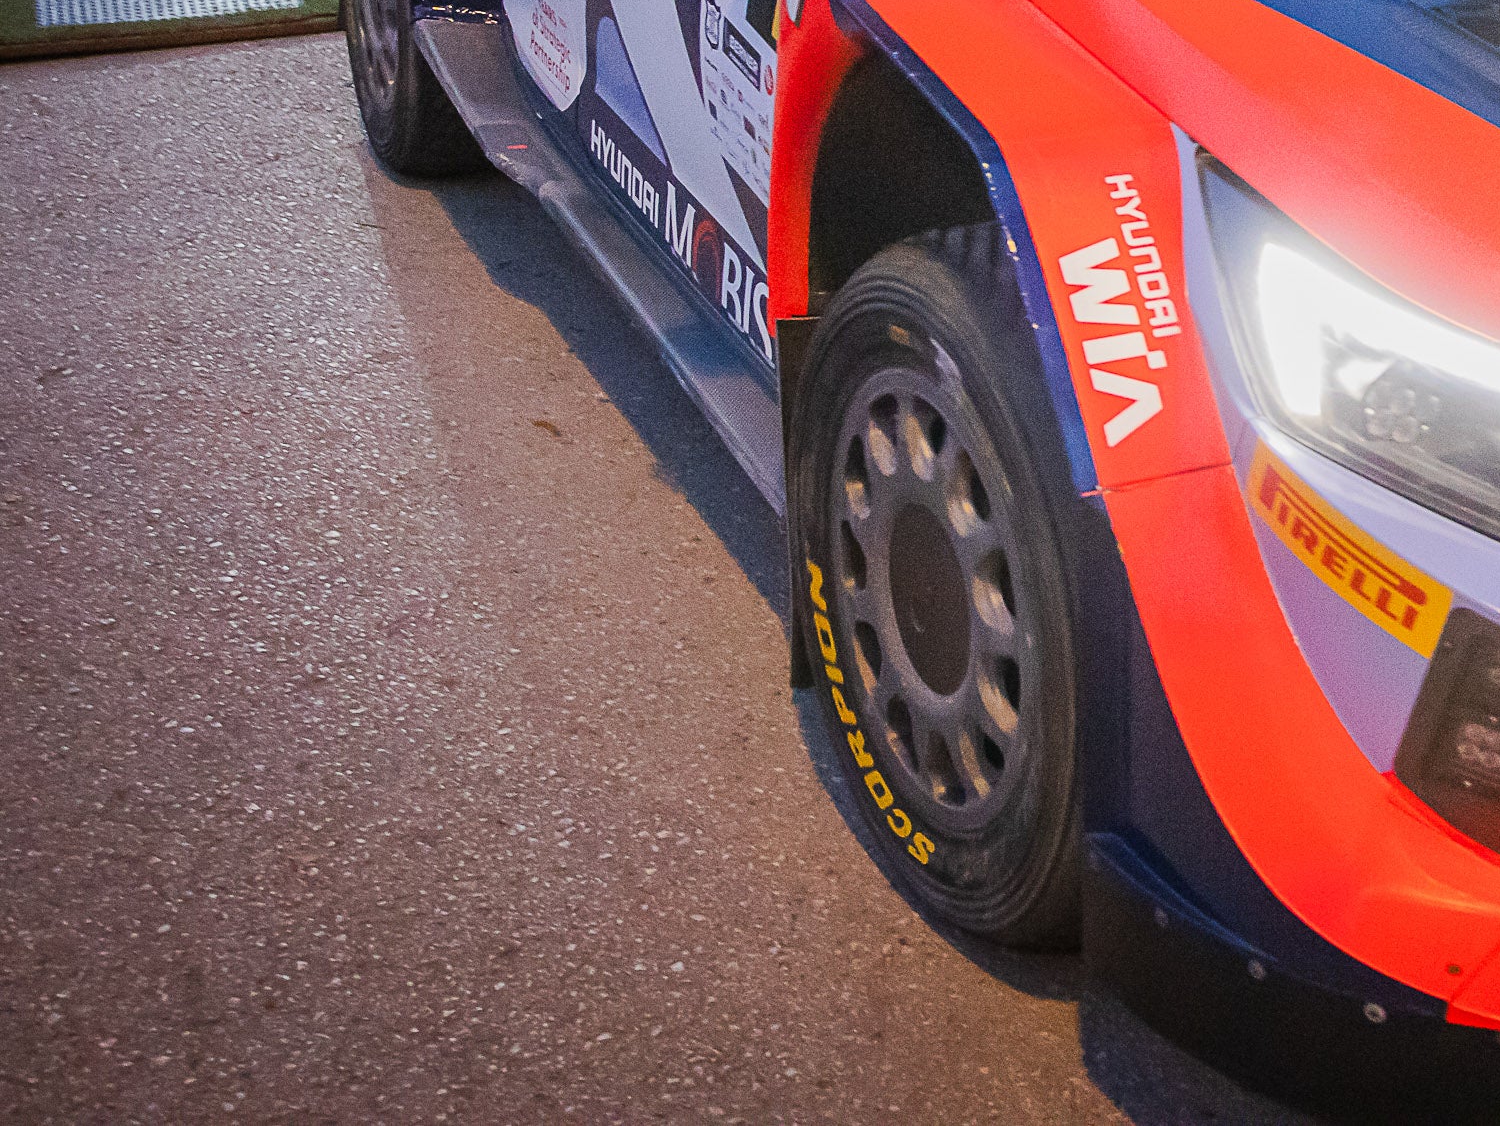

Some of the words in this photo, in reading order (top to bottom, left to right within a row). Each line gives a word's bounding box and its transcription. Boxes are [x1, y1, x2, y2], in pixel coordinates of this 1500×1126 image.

[589, 118, 661, 229] HYUNDAI
[1103, 173, 1182, 339] HYUNDAI
[664, 179, 776, 369] MOBIS
[1259, 463, 1429, 632] PIRELLI
[805, 558, 936, 866] SCORPION
